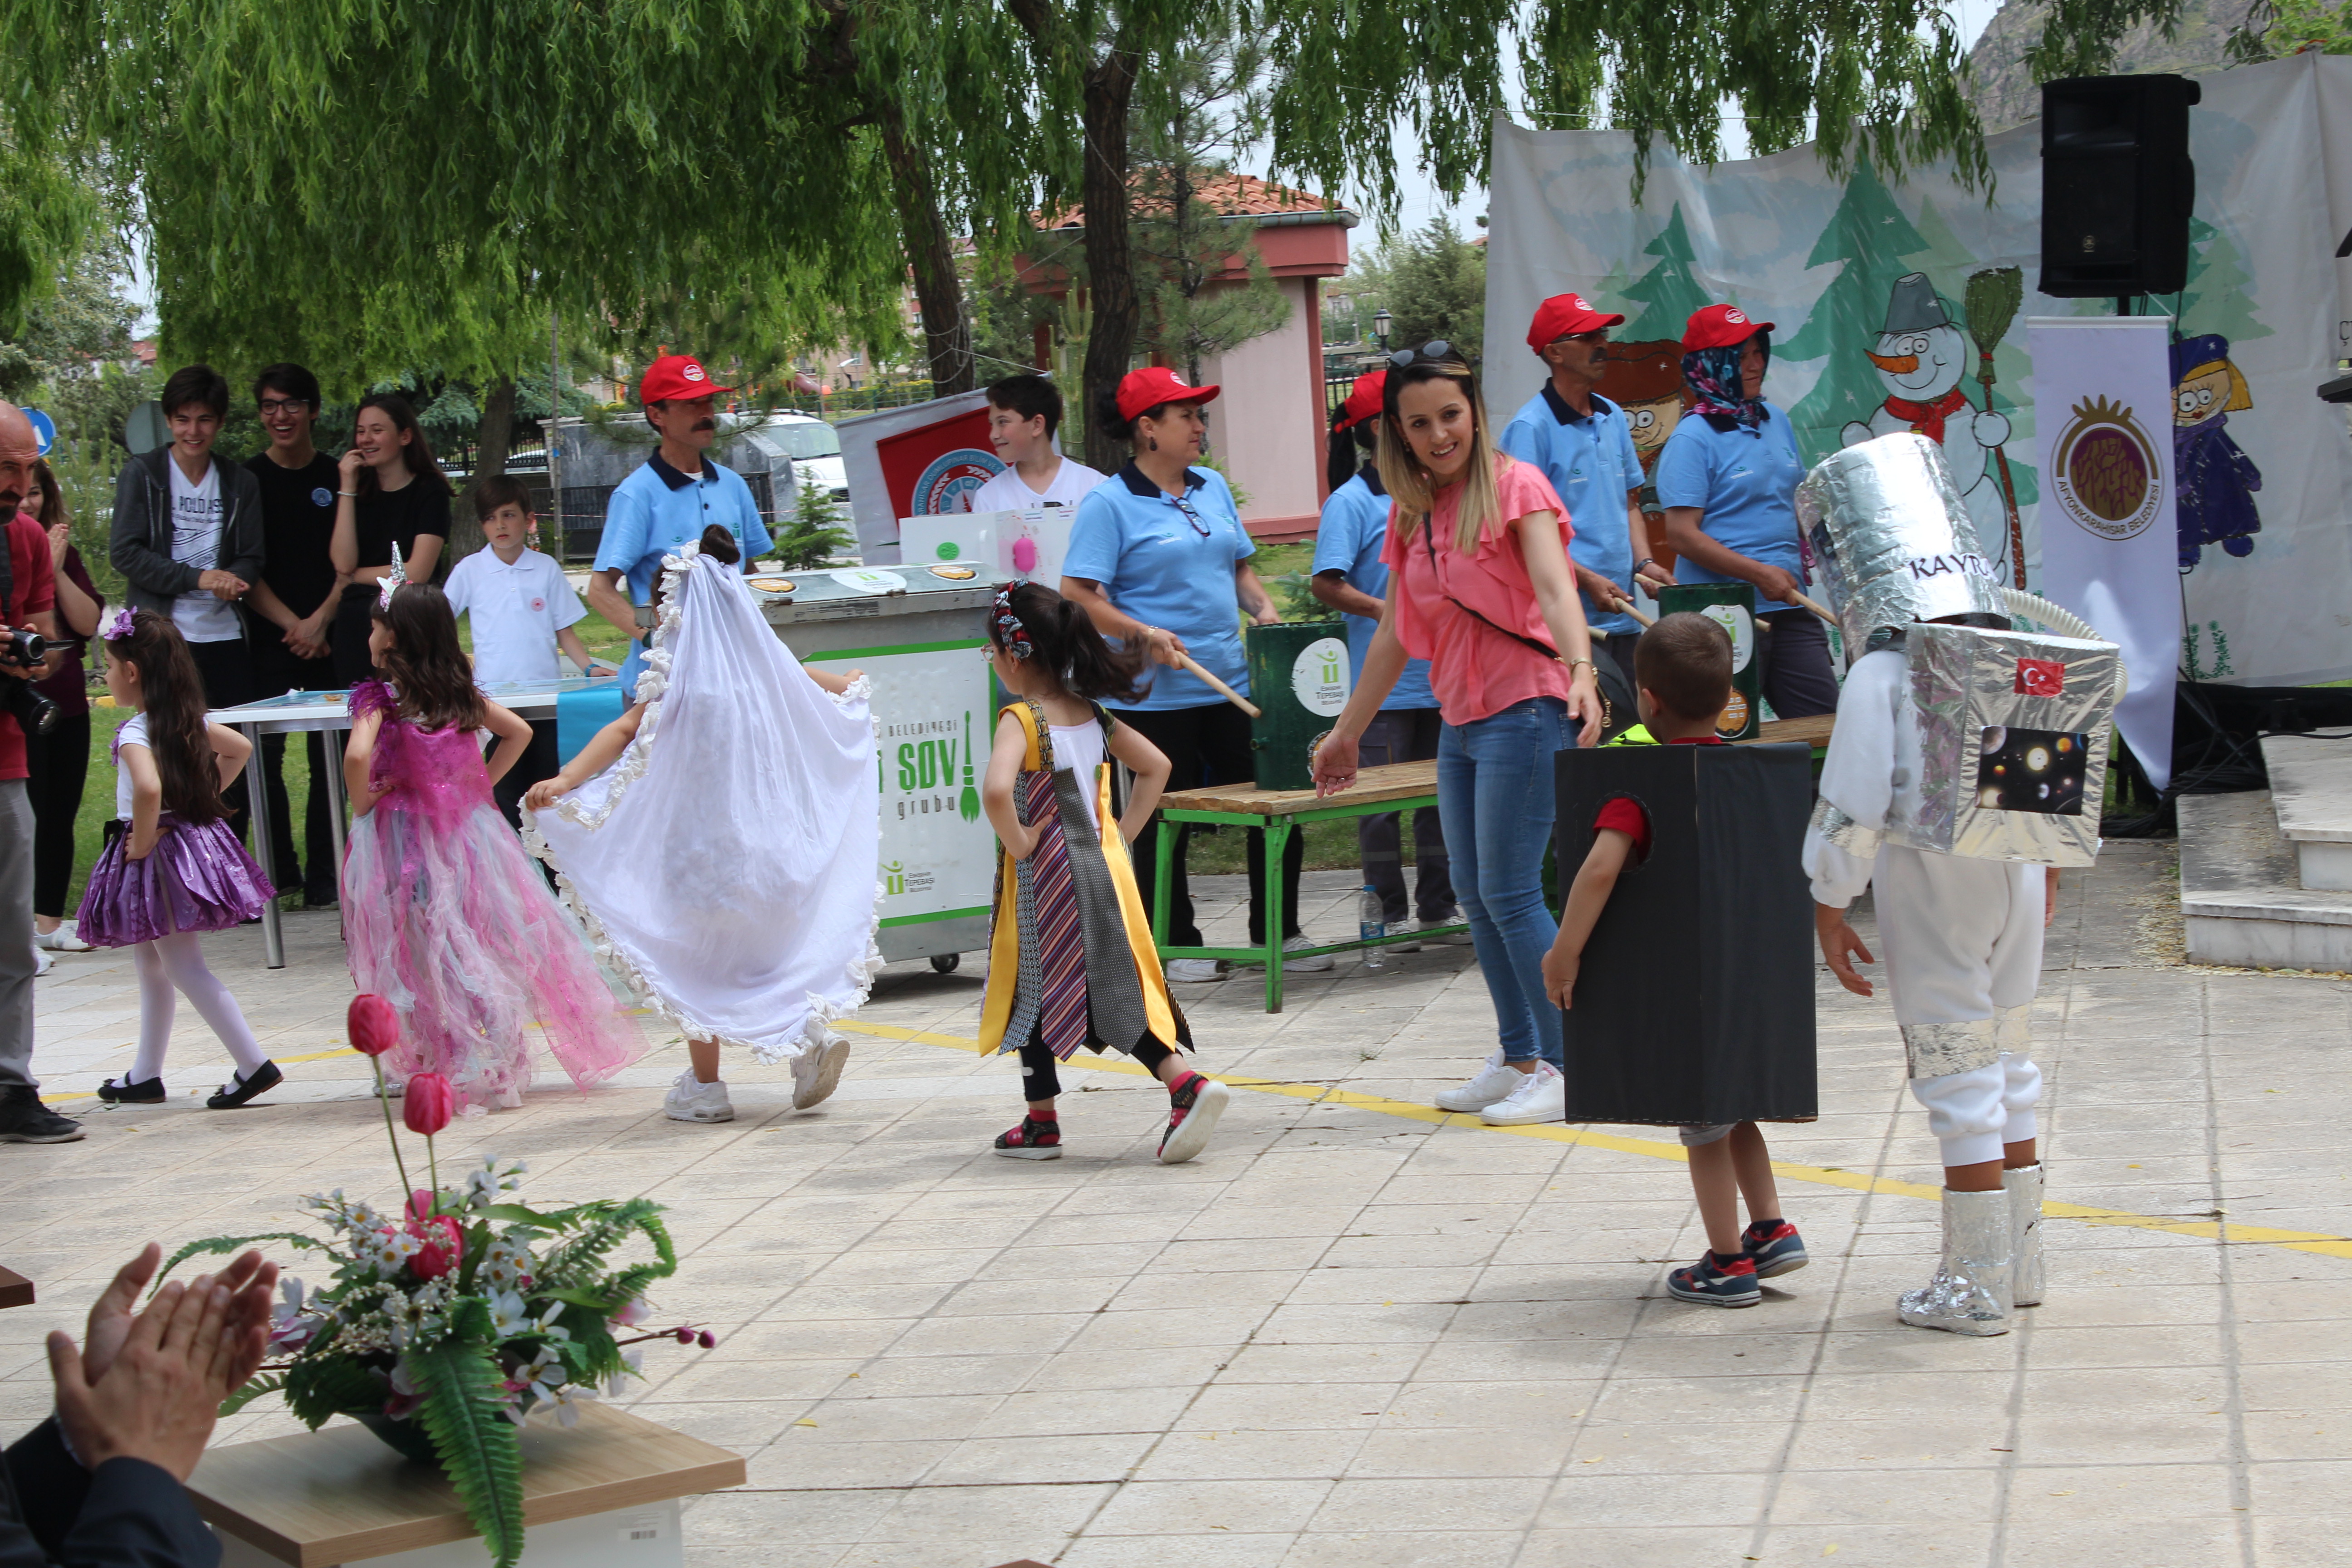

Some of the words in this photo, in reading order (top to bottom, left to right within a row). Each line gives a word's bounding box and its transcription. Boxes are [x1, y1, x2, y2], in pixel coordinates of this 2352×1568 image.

[2058, 481, 2128, 535] AFYONKARAHİSAR
[2128, 484, 2160, 531] BELEDİYESİ
[888, 720, 957, 737] BELEDİYESİ
[897, 794, 955, 820] grubu
